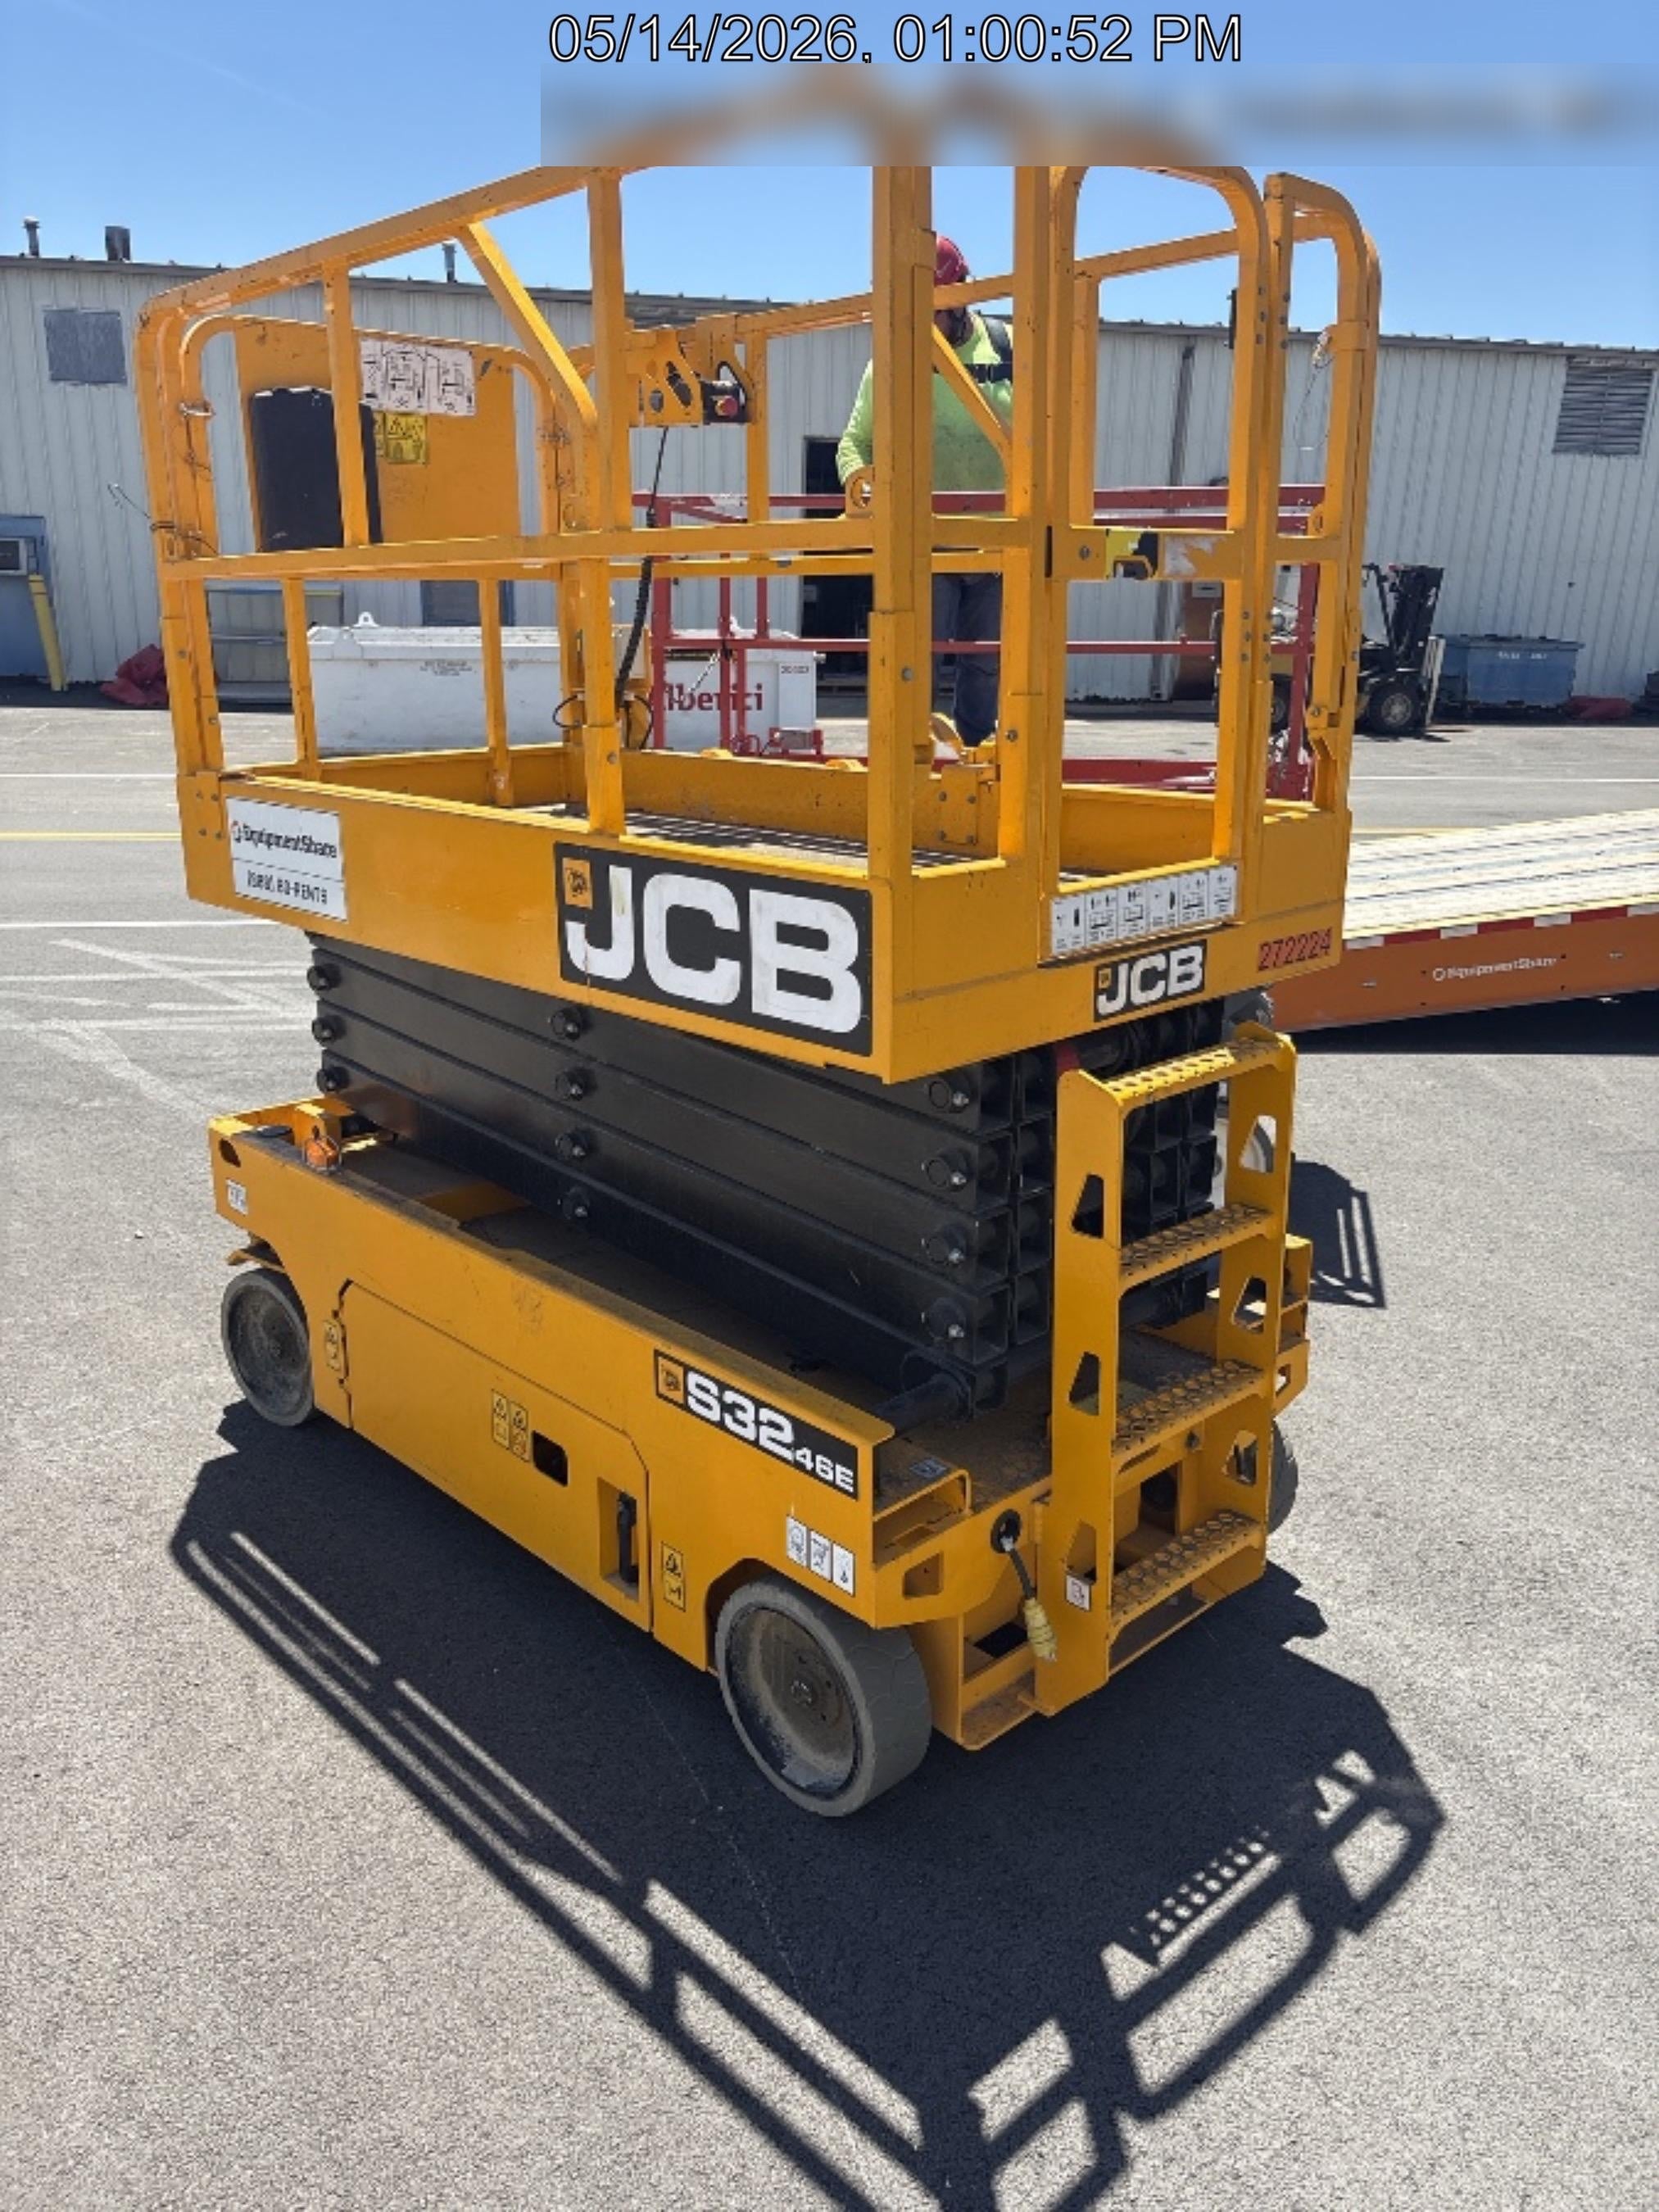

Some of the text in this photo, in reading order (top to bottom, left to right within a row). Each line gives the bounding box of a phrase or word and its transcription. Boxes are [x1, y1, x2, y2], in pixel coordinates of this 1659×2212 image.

[243, 823, 338, 859] EquipmentShare
[565, 864, 862, 1033] JCB
[1258, 927, 1332, 972] 272224
[1447, 957, 1557, 979] EquipmentShare
[1096, 945, 1204, 1016] JCB
